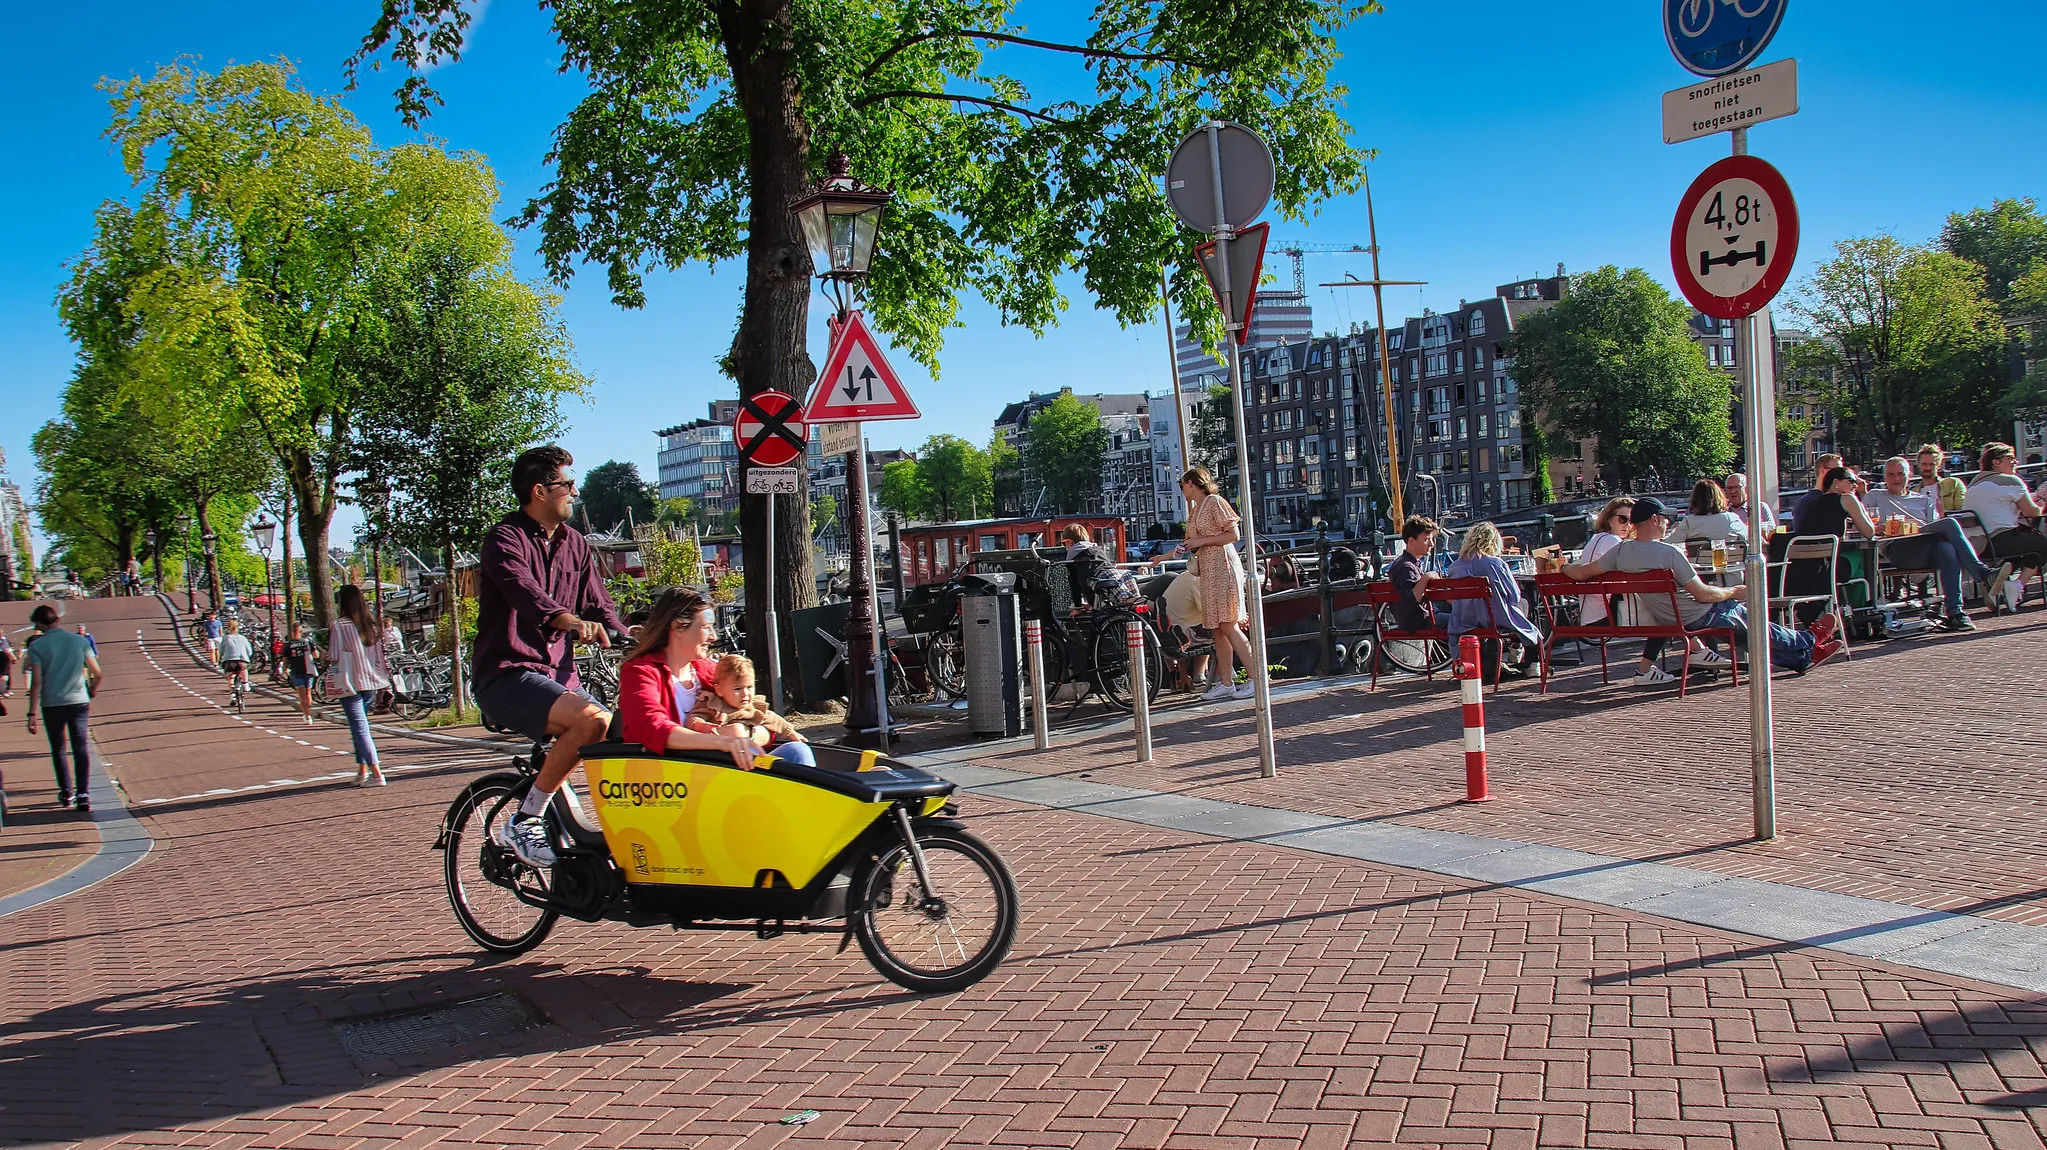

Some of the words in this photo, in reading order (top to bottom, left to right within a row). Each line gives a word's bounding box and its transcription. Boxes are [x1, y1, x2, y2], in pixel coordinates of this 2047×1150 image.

[1688, 72, 1761, 101] snorfietsen
[1714, 94, 1740, 110] niet
[1692, 106, 1762, 131] toegestaan
[748, 469, 797, 477] uitgezonderd
[599, 779, 688, 807] Cargoroo
